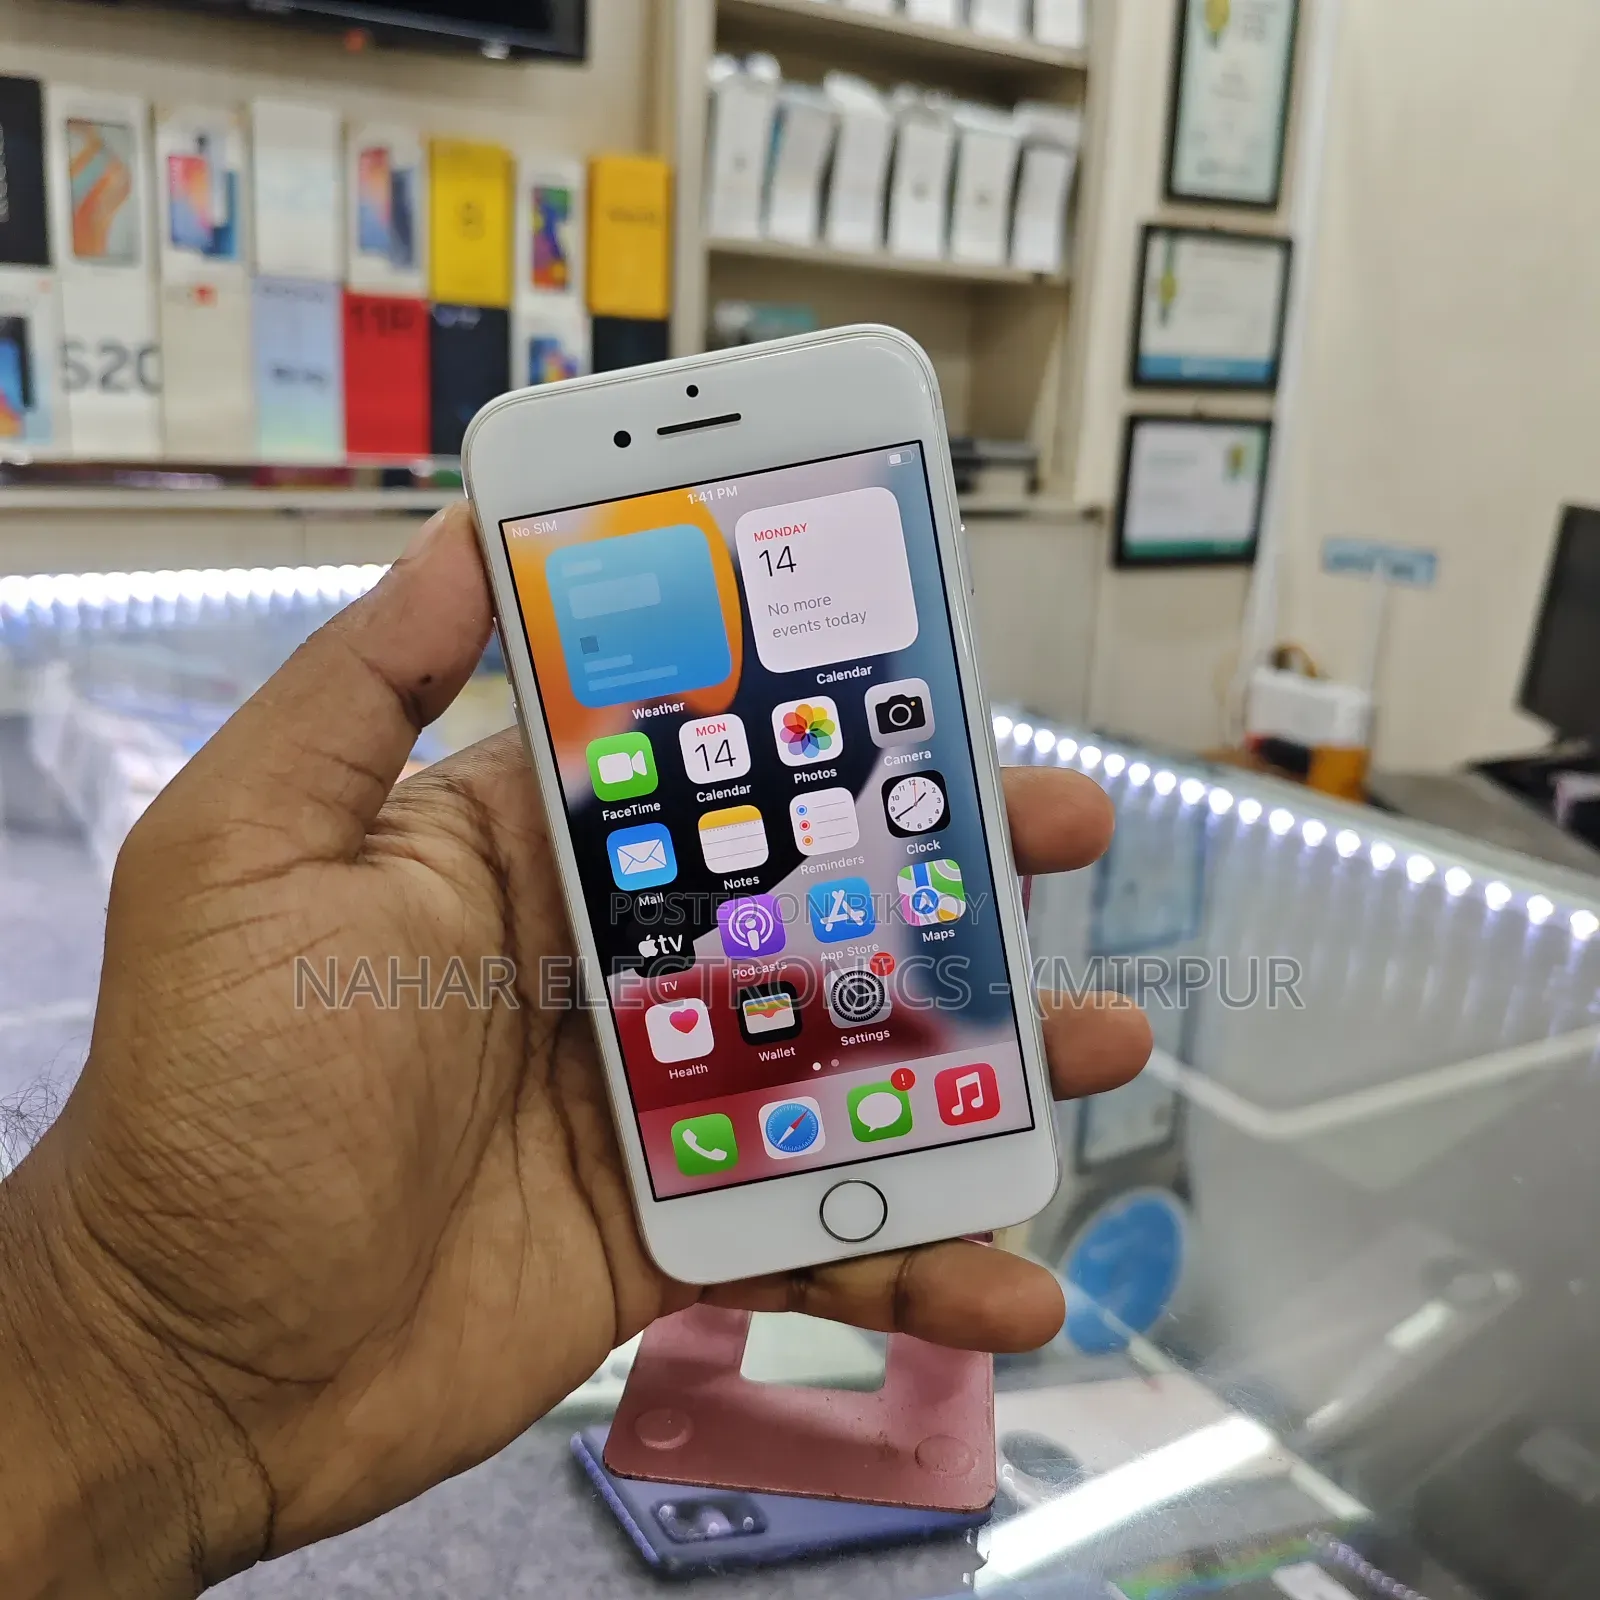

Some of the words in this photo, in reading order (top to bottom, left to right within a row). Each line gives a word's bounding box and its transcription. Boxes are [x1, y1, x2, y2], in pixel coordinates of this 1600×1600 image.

[687, 490, 714, 505] 1:41
[716, 485, 738, 501] PM
[512, 526, 530, 539] No
[533, 520, 558, 535] SIM
[753, 522, 808, 542] MONDAY
[758, 545, 797, 578] 14
[767, 602, 789, 617] No
[793, 595, 832, 612] more
[772, 619, 821, 638] events
[826, 610, 867, 631] today
[816, 665, 873, 685] Calendar
[631, 700, 685, 720] Weather
[695, 722, 727, 737] MON
[694, 739, 737, 772] 14
[883, 750, 932, 767] Camera
[793, 767, 838, 784] Photos
[696, 784, 752, 803] Calendar
[602, 801, 661, 821] FaceTime
[906, 839, 941, 855] Clock
[801, 855, 865, 875] Reminders
[723, 875, 760, 890] Notes
[638, 892, 664, 907] Mail
[657, 934, 683, 955] tv
[922, 928, 955, 943] Maps
[820, 949, 844, 962] App
[847, 943, 880, 957] Store
[732, 961, 788, 979] Podcasts
[661, 980, 678, 993] TV
[840, 1028, 891, 1046] Settings
[758, 1046, 796, 1062] Wallet
[668, 1063, 709, 1080] Health
